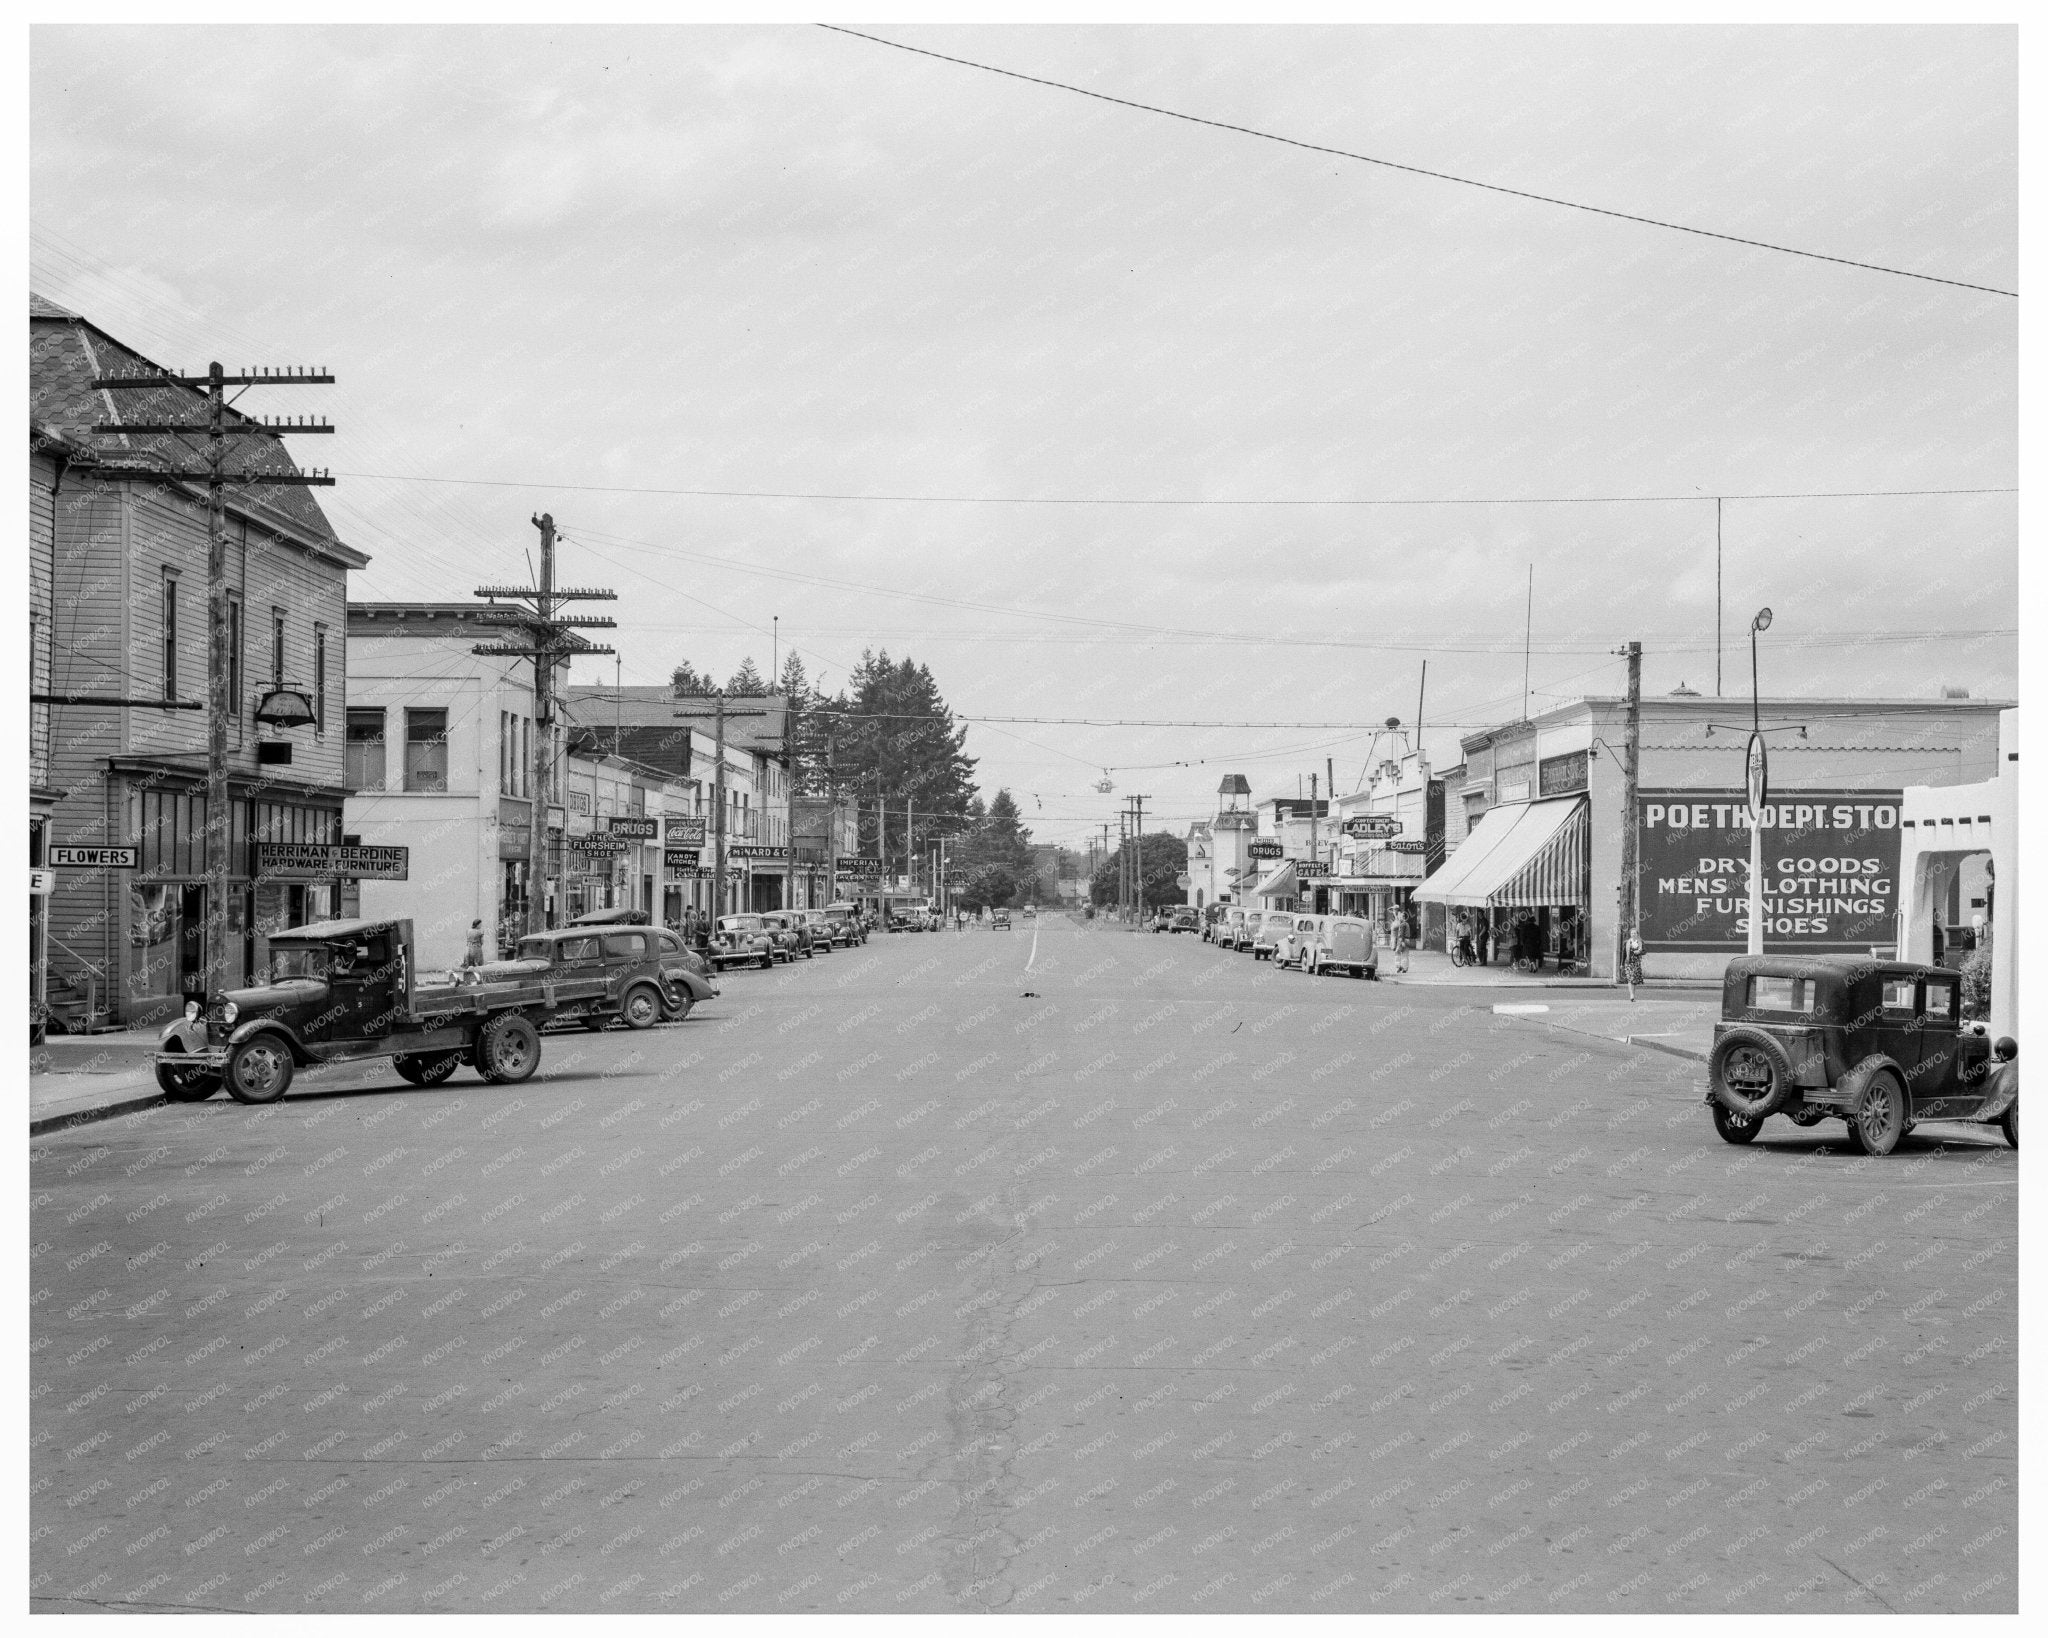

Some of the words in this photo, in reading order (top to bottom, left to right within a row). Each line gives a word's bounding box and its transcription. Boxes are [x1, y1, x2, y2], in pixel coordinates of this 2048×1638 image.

[1760, 804, 1829, 829] DEPT.
[1832, 804, 1903, 829] STO
[612, 822, 654, 836] DRUGS
[1343, 823, 1401, 833] LADLEY'S
[261, 844, 329, 859] HERRIMAN
[340, 847, 403, 861] BERDINE
[573, 841, 626, 850] FLORSHEIM
[773, 848, 780, 857] &
[1252, 847, 1281, 856] DRUGS
[57, 849, 129, 864] FLOWERS
[262, 858, 328, 869] HARDWARE
[335, 859, 400, 872] FURNITURE
[1777, 857, 1881, 874] GOODS
[1298, 868, 1322, 877] CAFE
[30, 875, 43, 889] E
[1658, 878, 1728, 894] MENS
